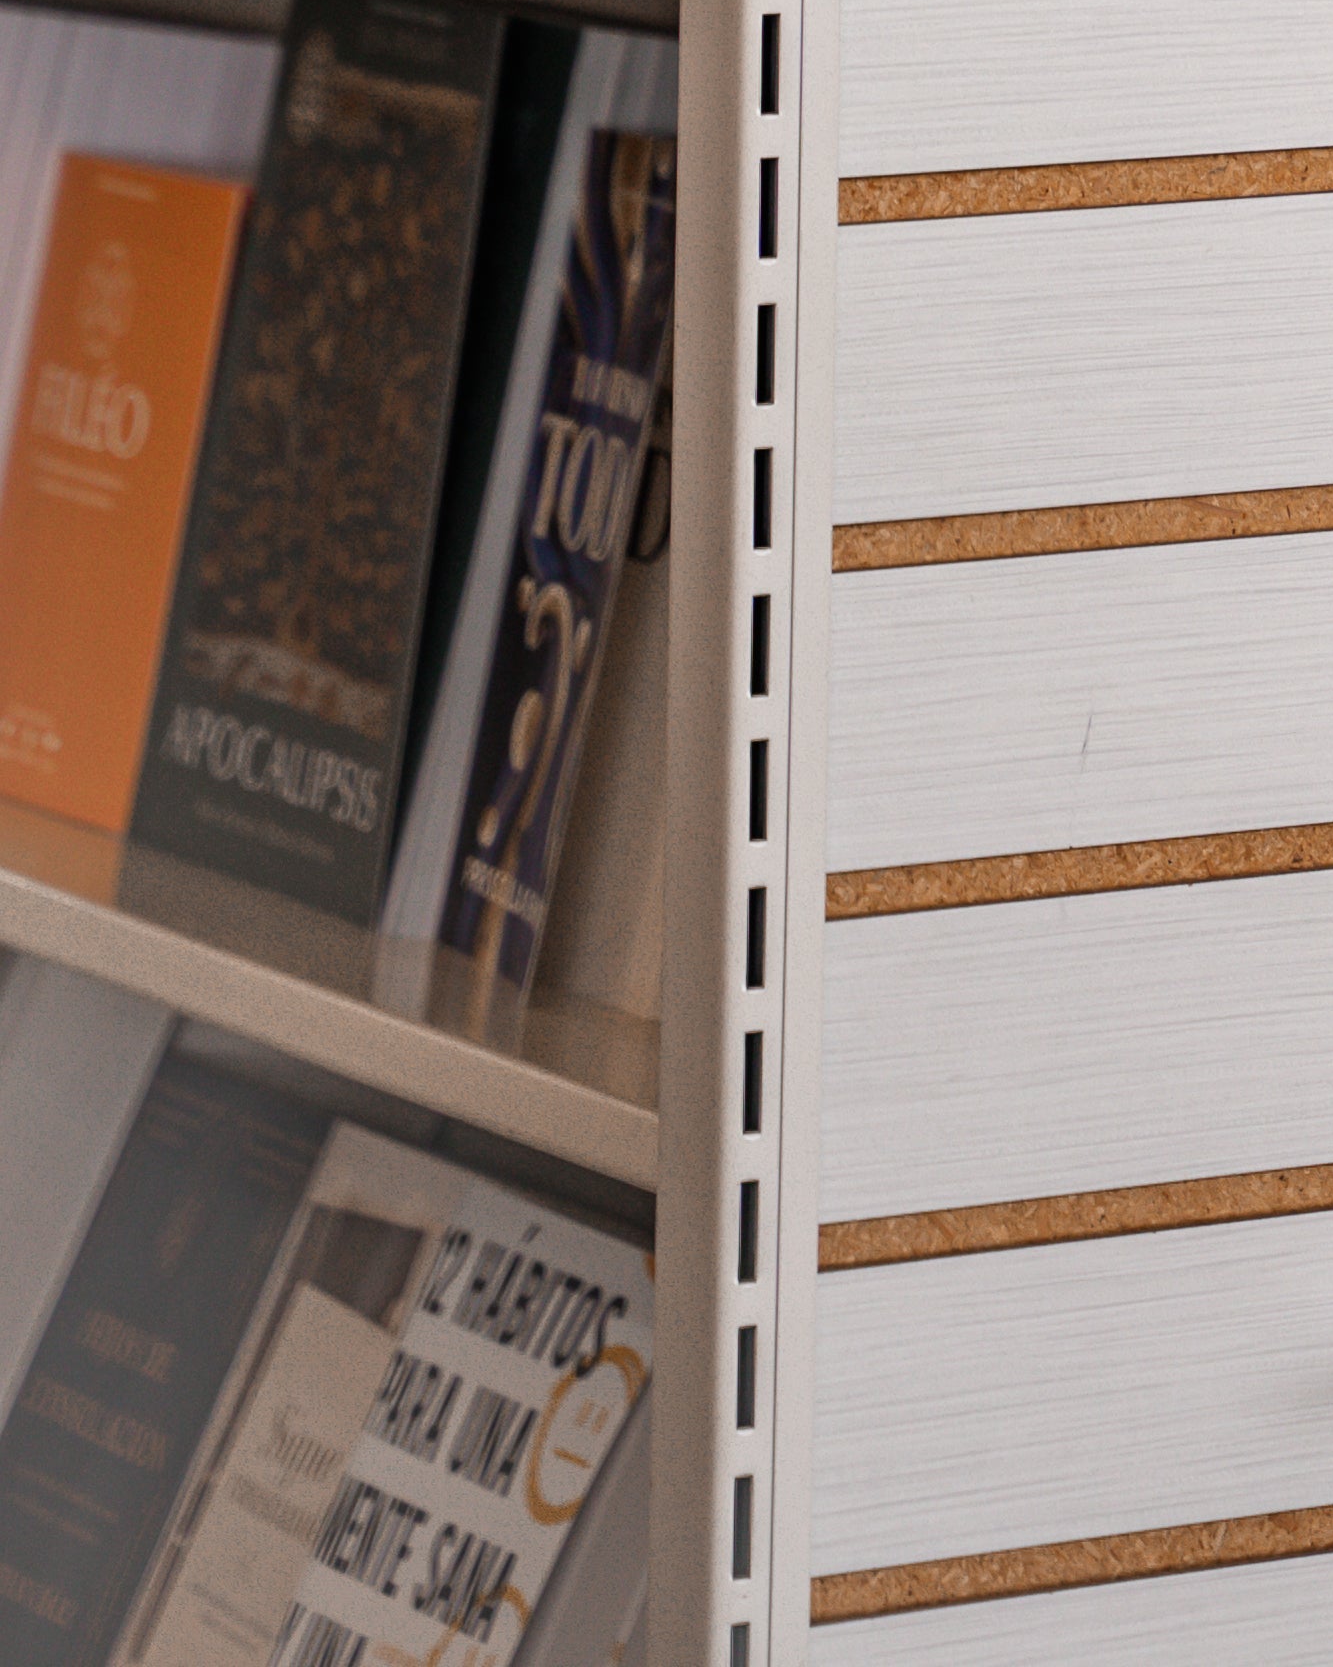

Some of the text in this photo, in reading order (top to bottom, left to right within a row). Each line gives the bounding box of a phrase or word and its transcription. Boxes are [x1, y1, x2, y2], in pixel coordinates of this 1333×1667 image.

[422, 1223, 627, 1377] 12 HÁBITOS
[363, 1349, 462, 1464] PARA
[449, 1384, 539, 1497] UNA
